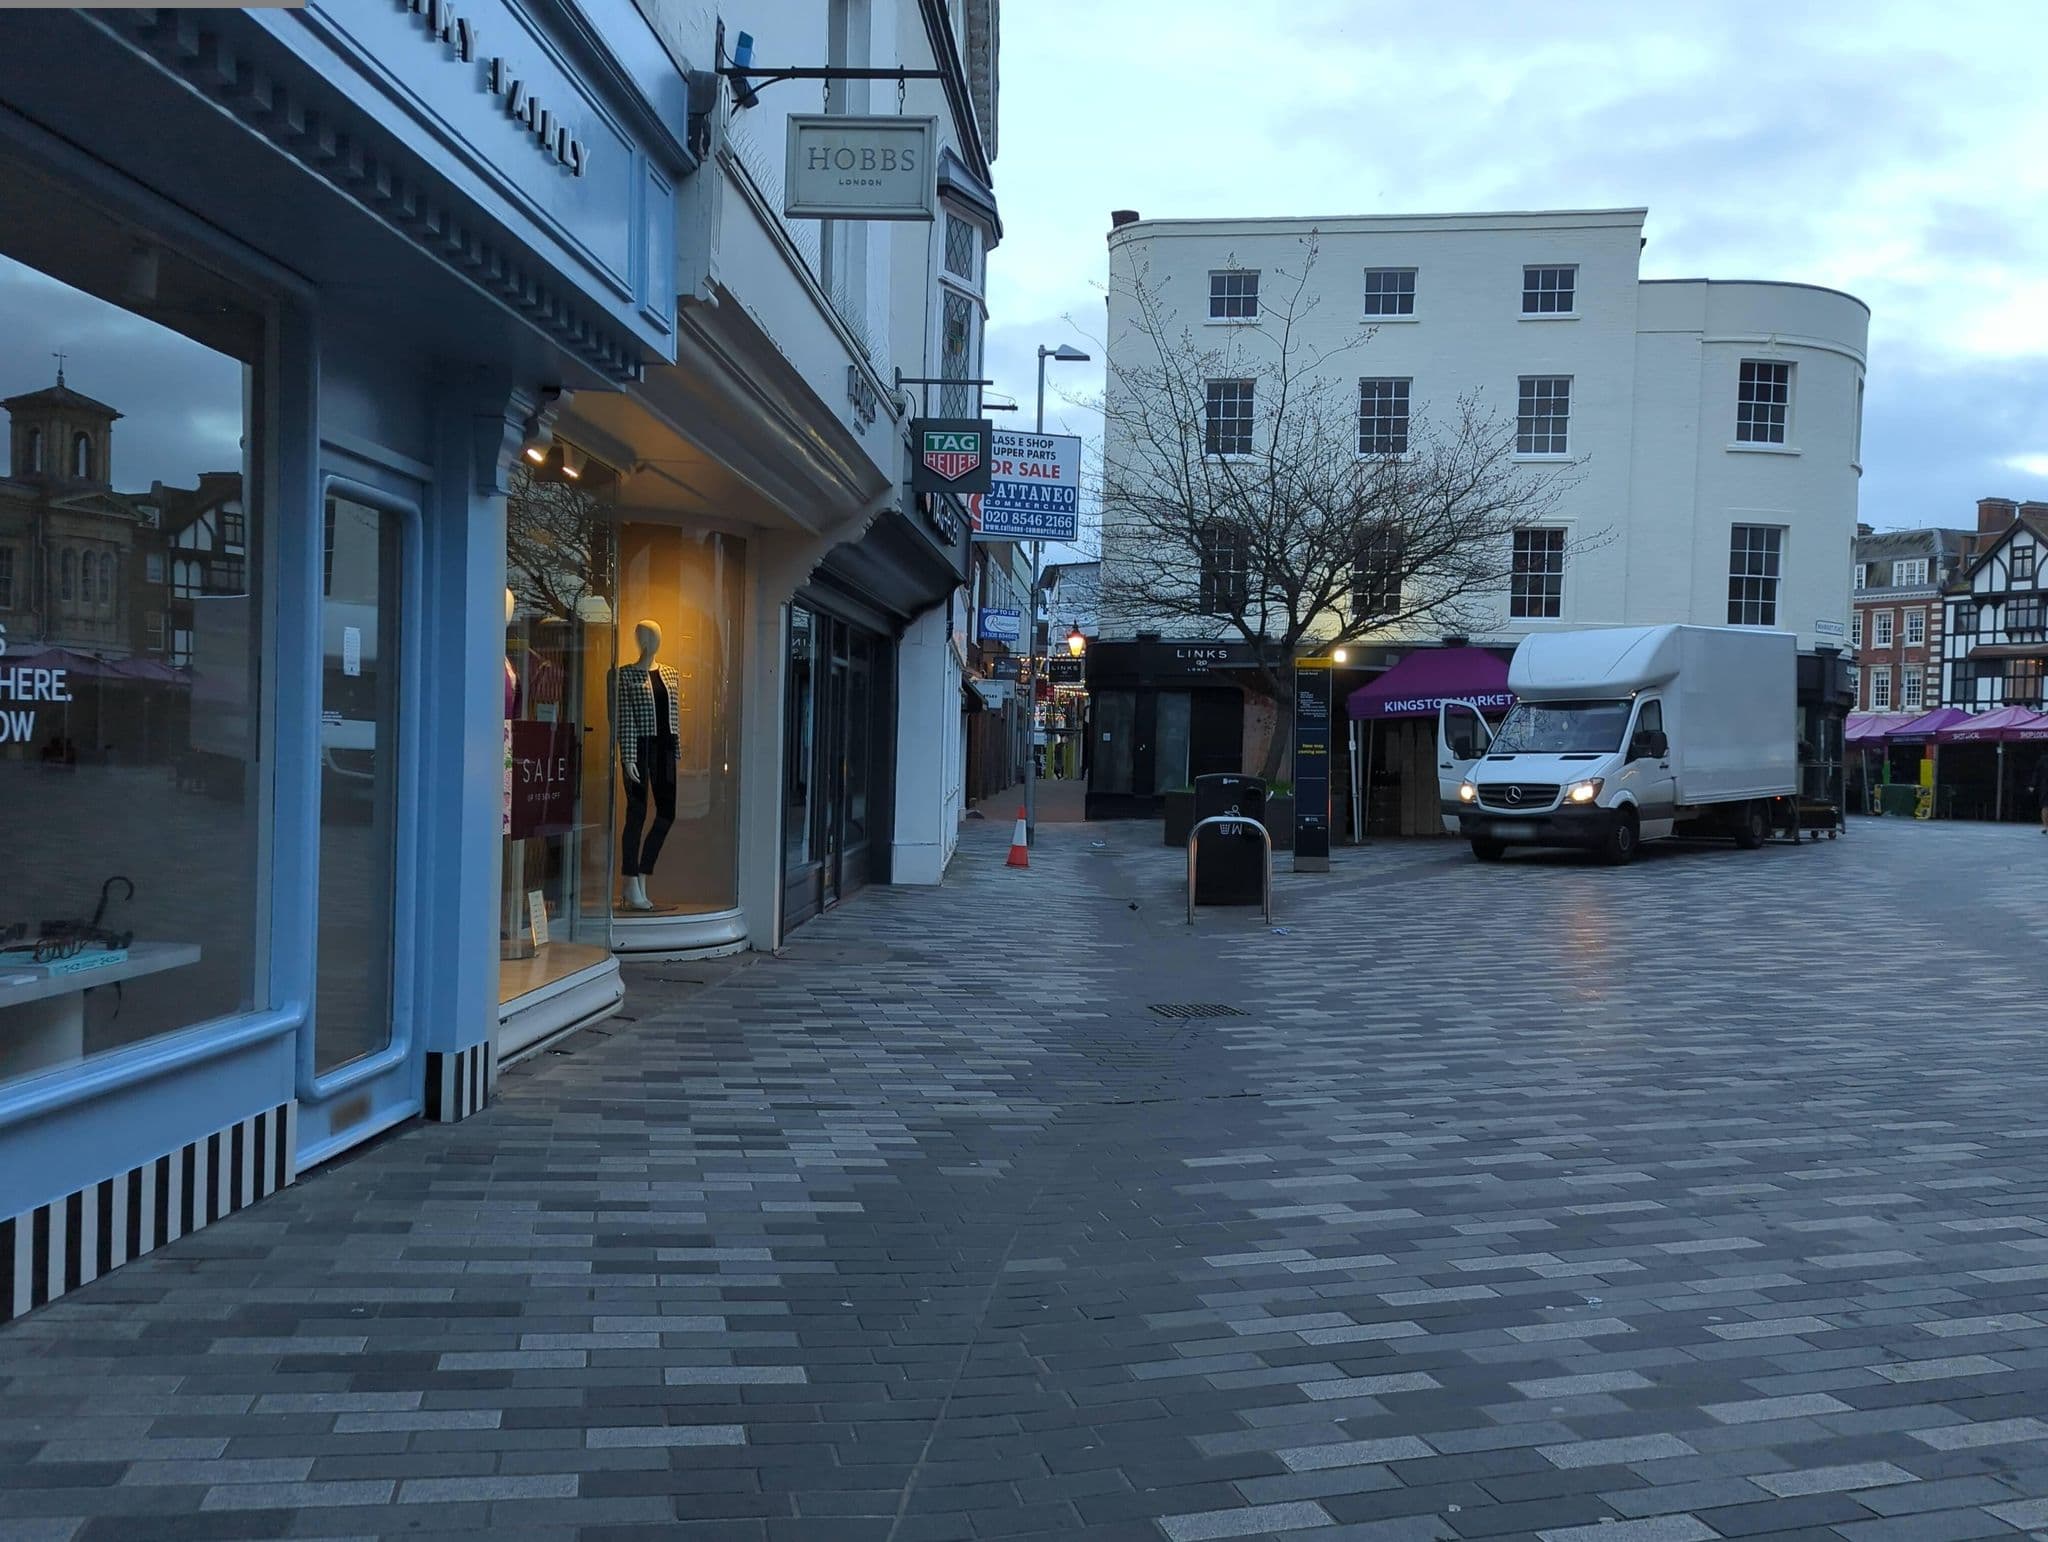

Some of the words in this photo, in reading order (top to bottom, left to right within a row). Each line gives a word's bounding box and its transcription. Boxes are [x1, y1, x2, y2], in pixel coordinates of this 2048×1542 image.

[807, 147, 915, 172] HOBBS
[929, 435, 975, 451] TAG
[992, 436, 1016, 446] LASS
[1018, 438, 1024, 447] E
[1026, 438, 1054, 449] SHOP
[993, 446, 1024, 458] UPPER
[1026, 449, 1057, 461] PARTS
[927, 453, 978, 477] HEUER
[991, 460, 1013, 475] OR
[1019, 462, 1061, 479] SALE
[985, 499, 1073, 512] COMMERCIAL
[985, 511, 1009, 523] 020
[1012, 513, 1042, 526] 8546
[1045, 515, 1073, 528] 2166
[1176, 649, 1228, 659] LINKS
[1384, 698, 1453, 713] KINGSTO
[0, 711, 35, 742] OW
[523, 758, 565, 783] SALE
